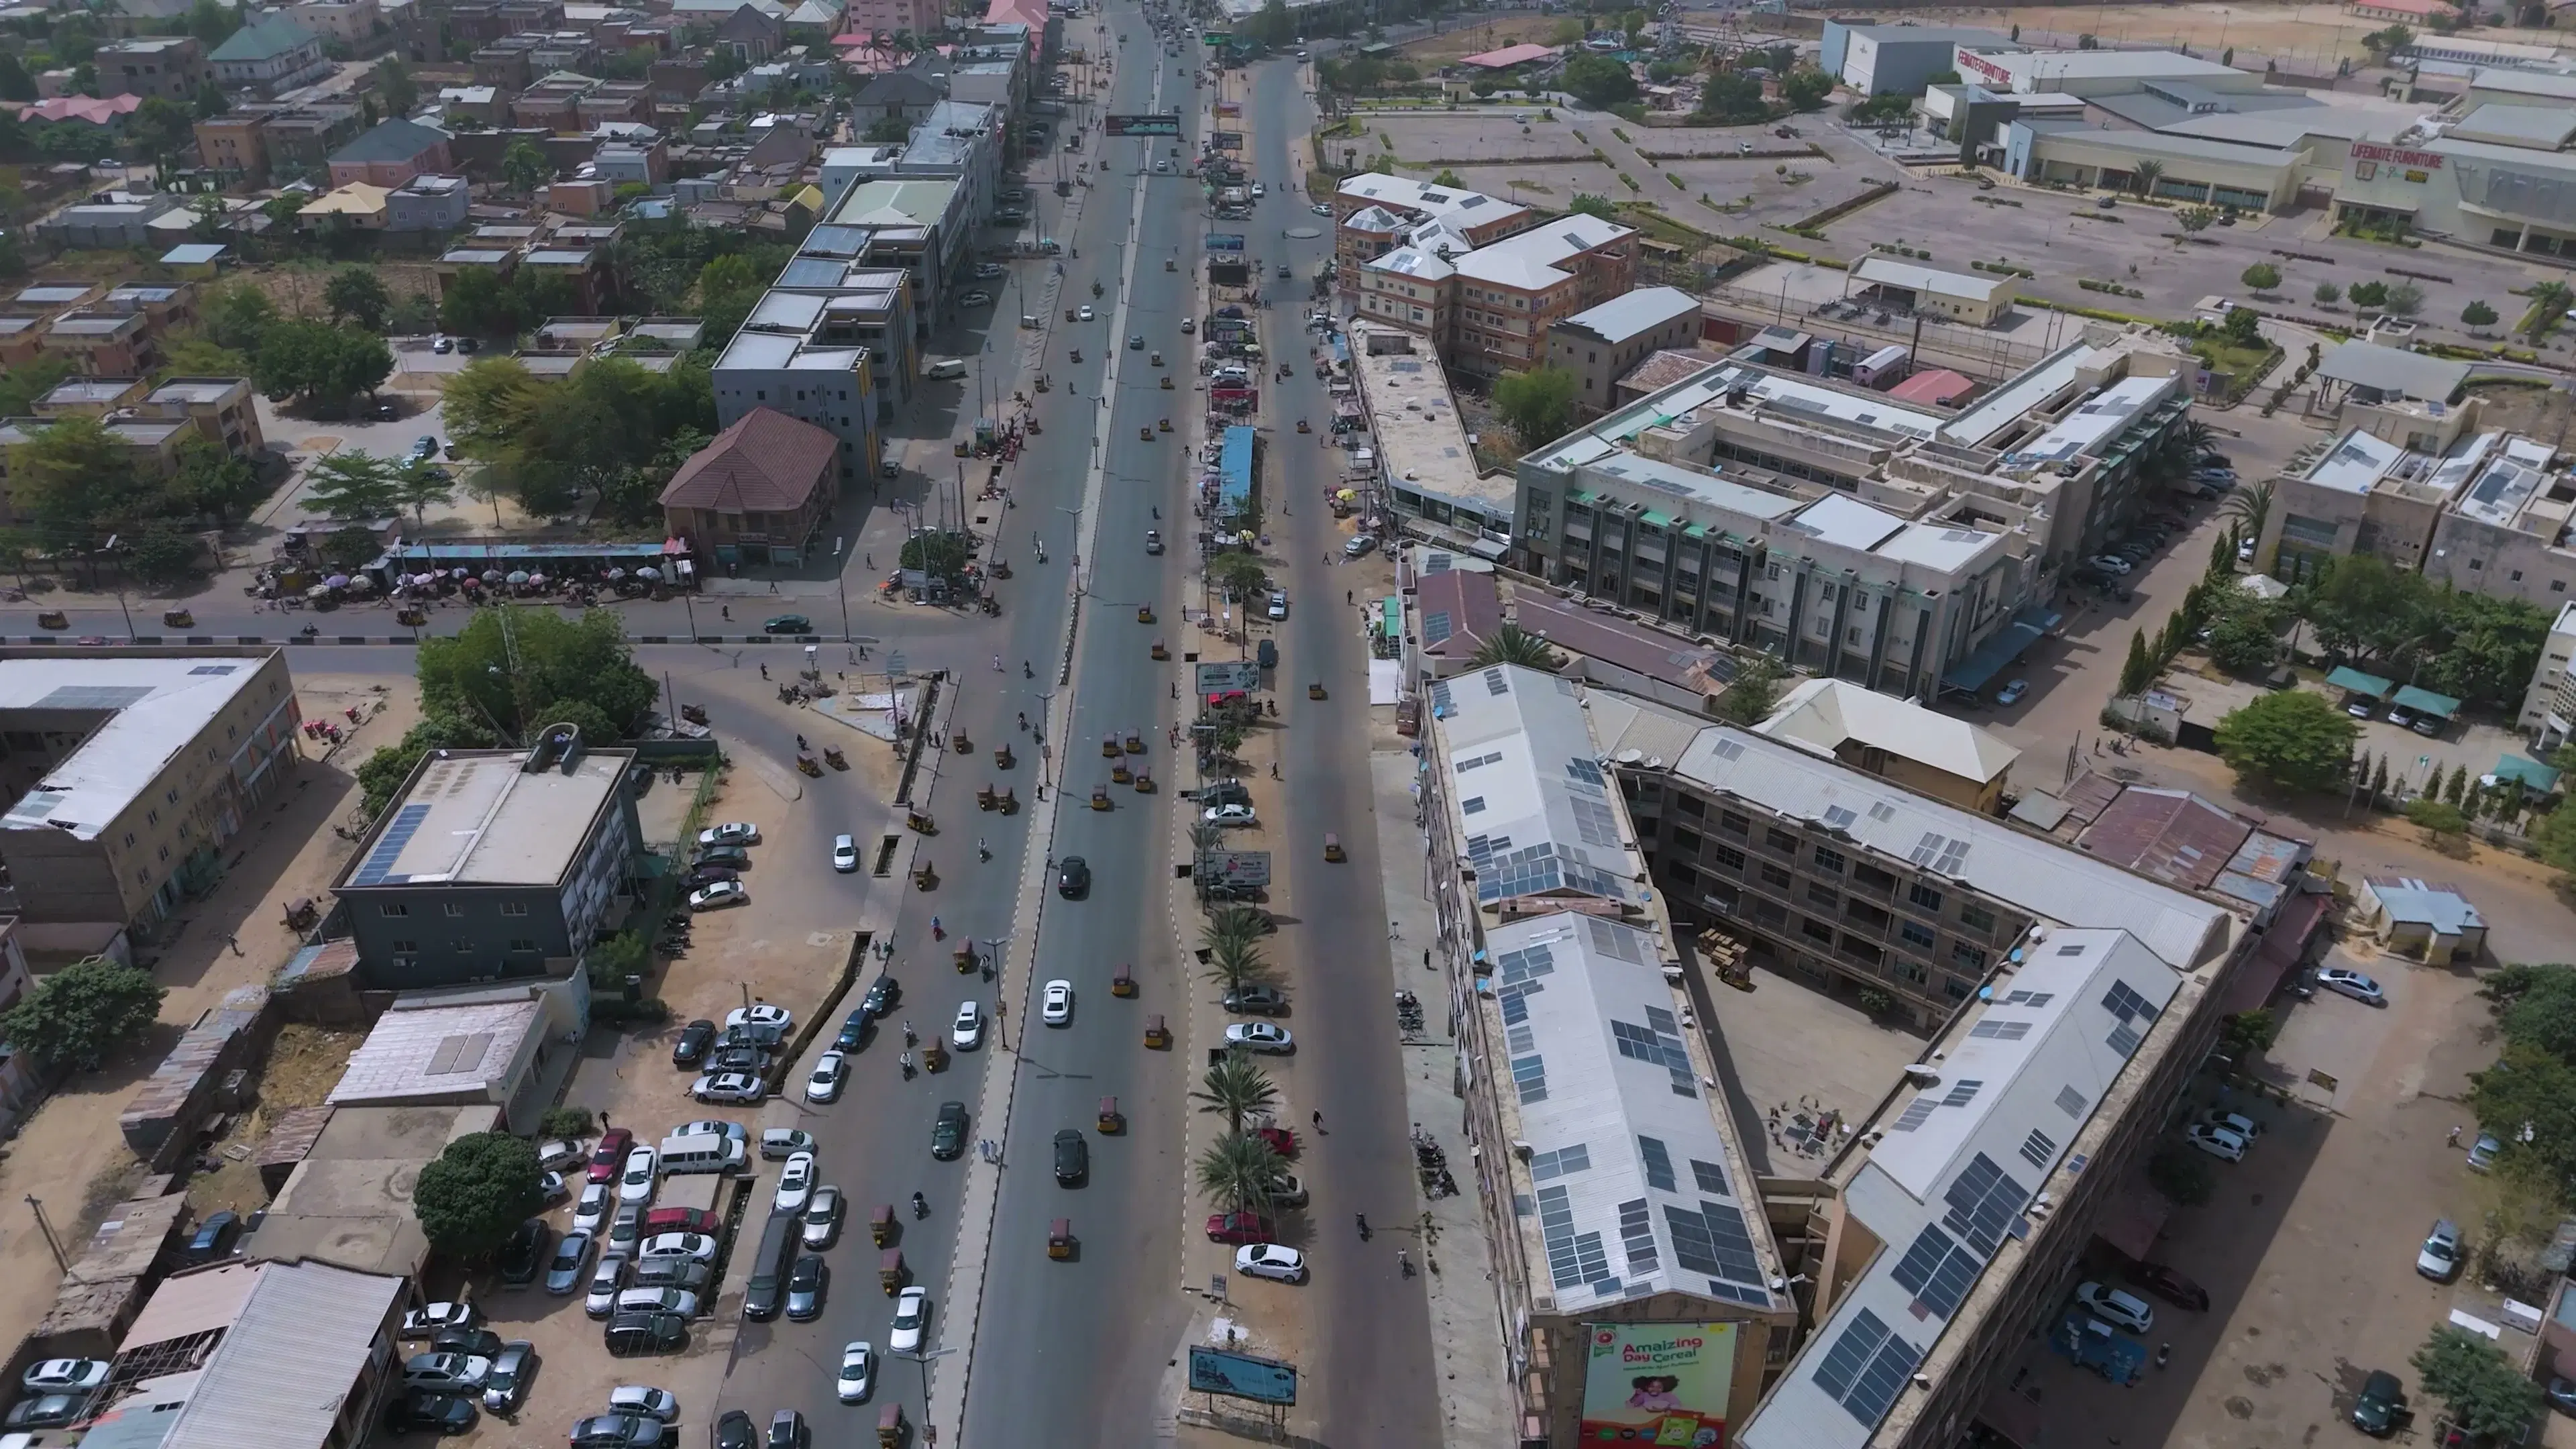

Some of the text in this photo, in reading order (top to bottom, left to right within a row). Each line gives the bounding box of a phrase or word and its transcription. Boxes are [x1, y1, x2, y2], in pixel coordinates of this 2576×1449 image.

[2351, 144, 2445, 168] LIFEMATE FURNITURE
[1623, 1337, 1703, 1355] Amaizing
[1623, 1347, 1697, 1363] Day Cereal
